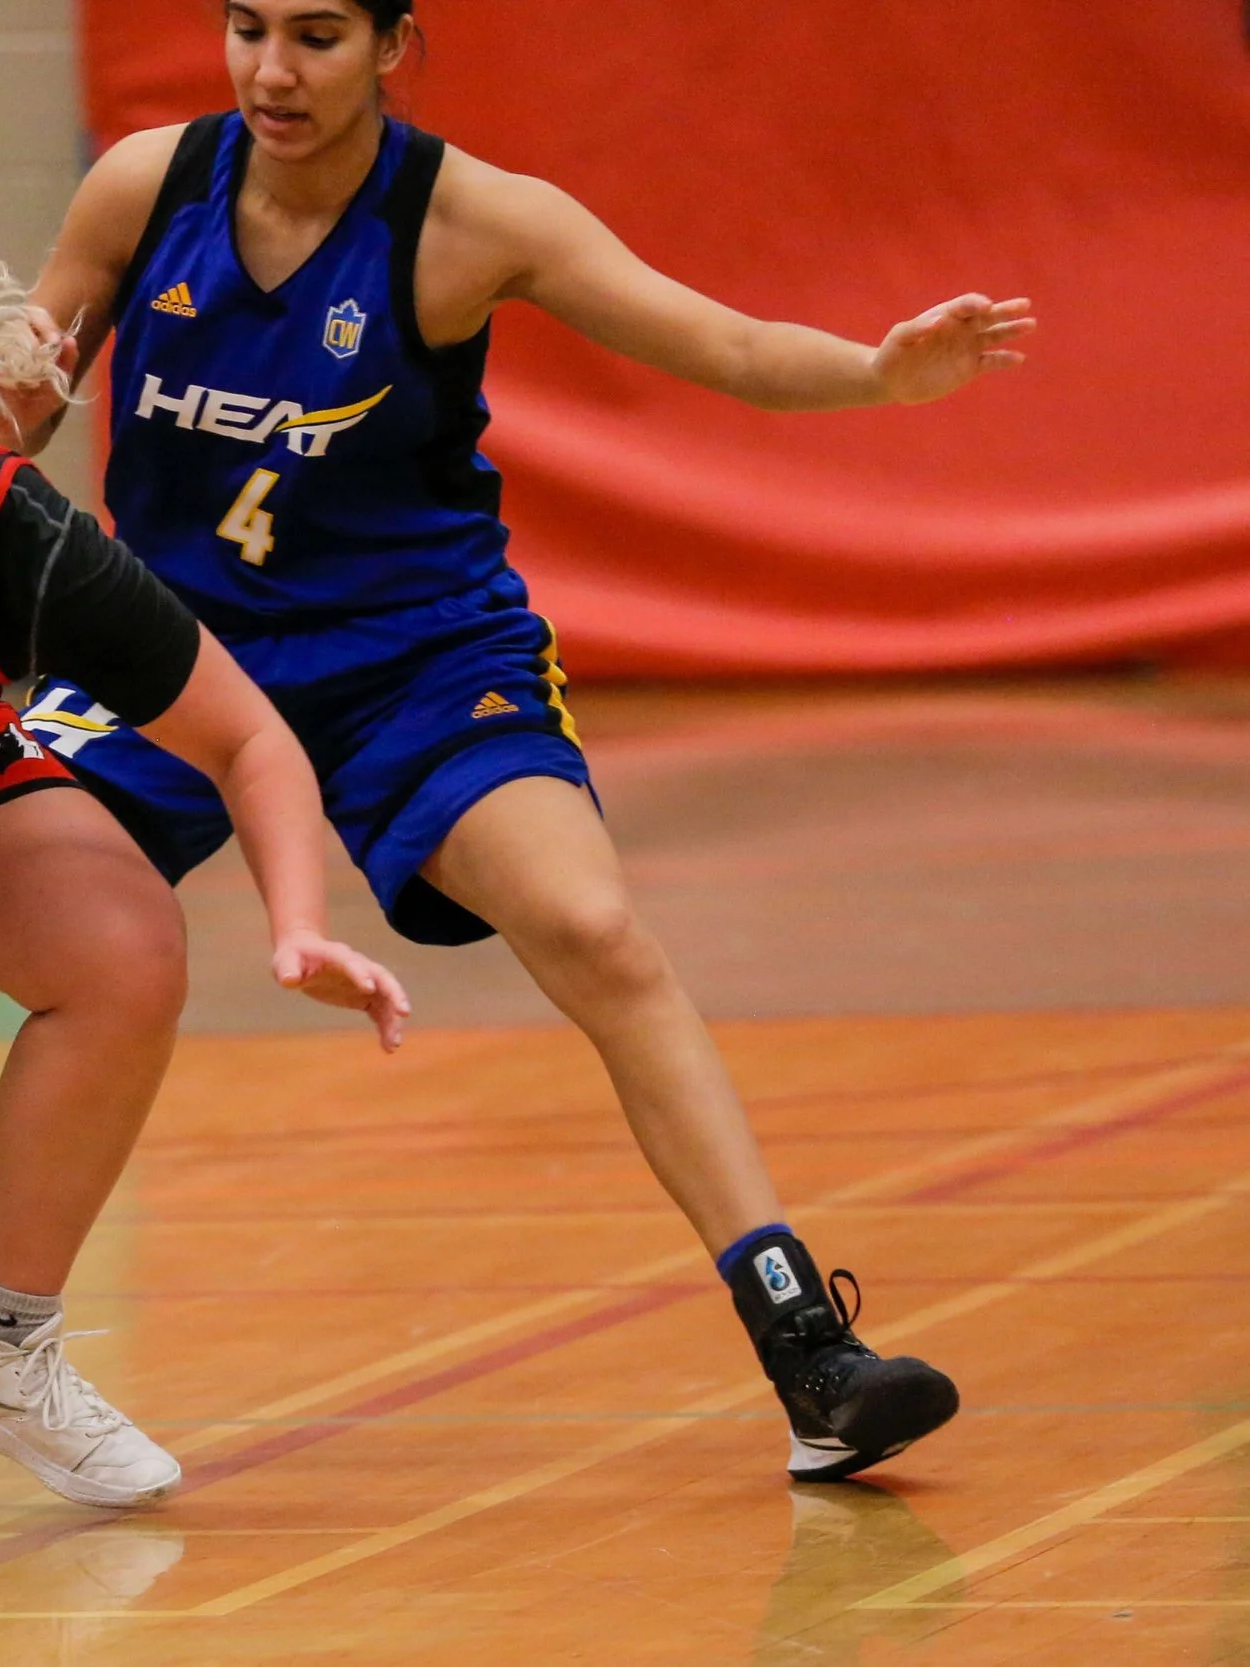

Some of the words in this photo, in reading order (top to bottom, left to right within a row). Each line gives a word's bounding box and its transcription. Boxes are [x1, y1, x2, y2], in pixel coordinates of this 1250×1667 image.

[150, 298, 198, 318] adidas
[328, 318, 361, 350] CW
[134, 372, 394, 457] HEAT
[215, 466, 281, 567] 4
[470, 703, 519, 719] adidas
